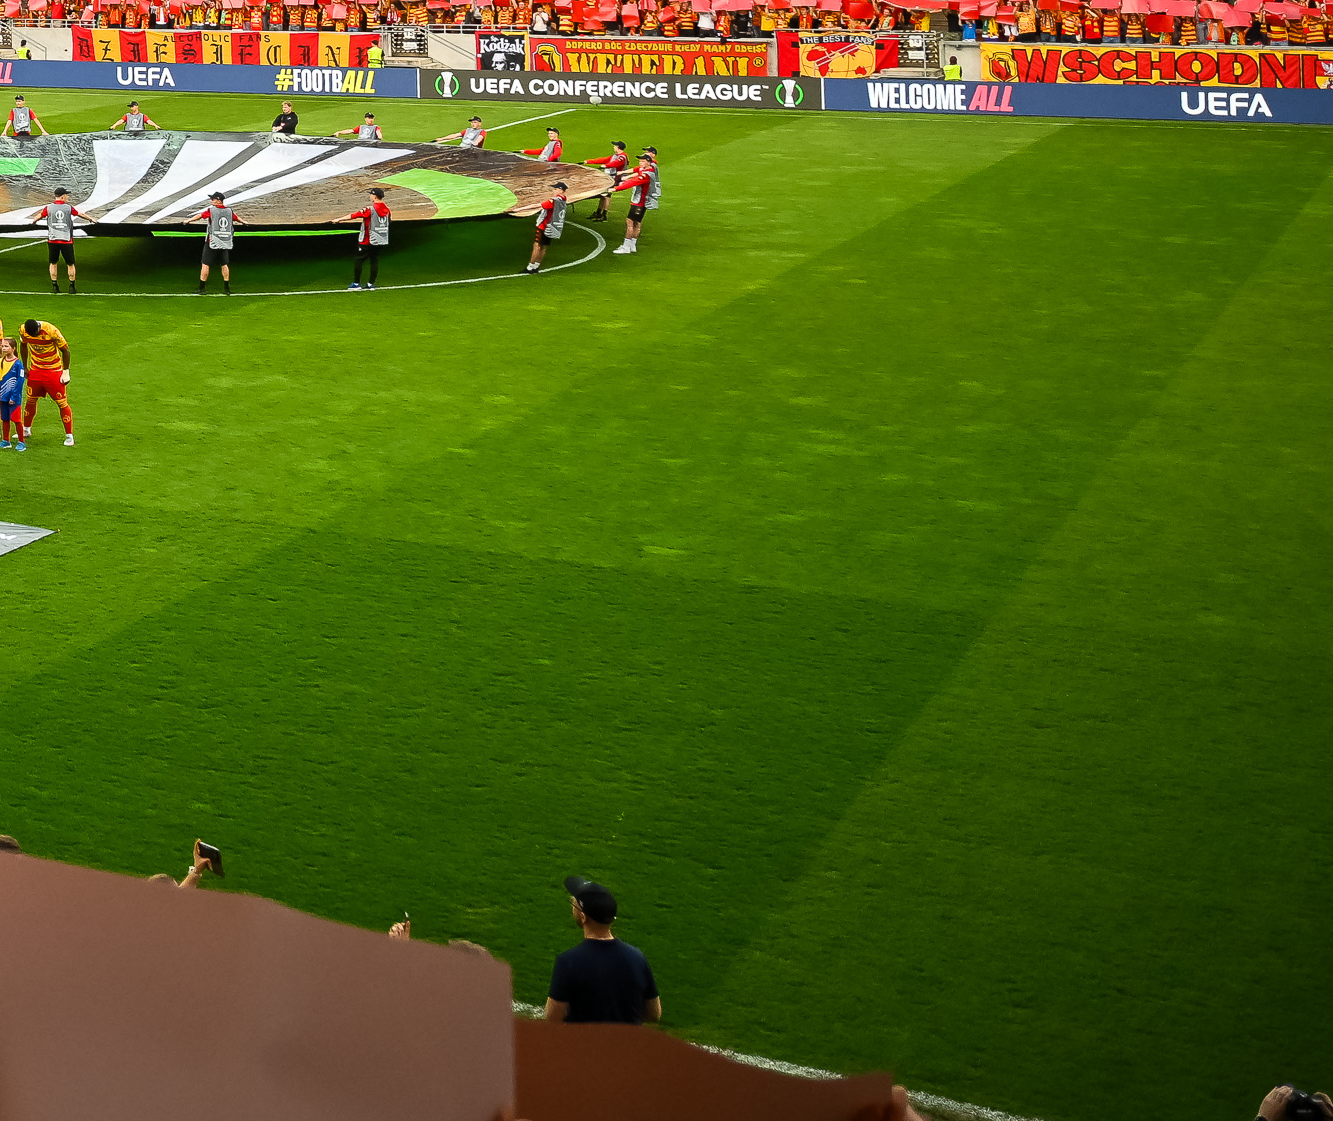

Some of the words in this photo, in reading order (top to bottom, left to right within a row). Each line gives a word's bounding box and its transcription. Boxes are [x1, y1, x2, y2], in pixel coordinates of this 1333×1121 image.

[163, 33, 230, 43] ALCOHOLIC
[239, 34, 271, 43] FANS
[565, 40, 603, 50] DOPIERO
[604, 40, 623, 50] BÓG
[675, 43, 701, 52] KIEDY
[703, 44, 732, 53] MAMY
[801, 36, 819, 45] THE
[822, 35, 846, 44] BEST
[849, 35, 874, 45] FANS
[566, 52, 750, 76] WETERANI
[1012, 48, 1318, 89] WSCHODNI
[117, 66, 175, 87] UEFA
[275, 67, 375, 94] #FOOTBALL
[470, 78, 524, 95] UEFA
[529, 79, 669, 99] CONFERENCE
[675, 83, 762, 102] LEAGUE
[867, 82, 967, 111] WELCOME
[968, 85, 1014, 112] ALL
[1181, 91, 1273, 117] UEFA
